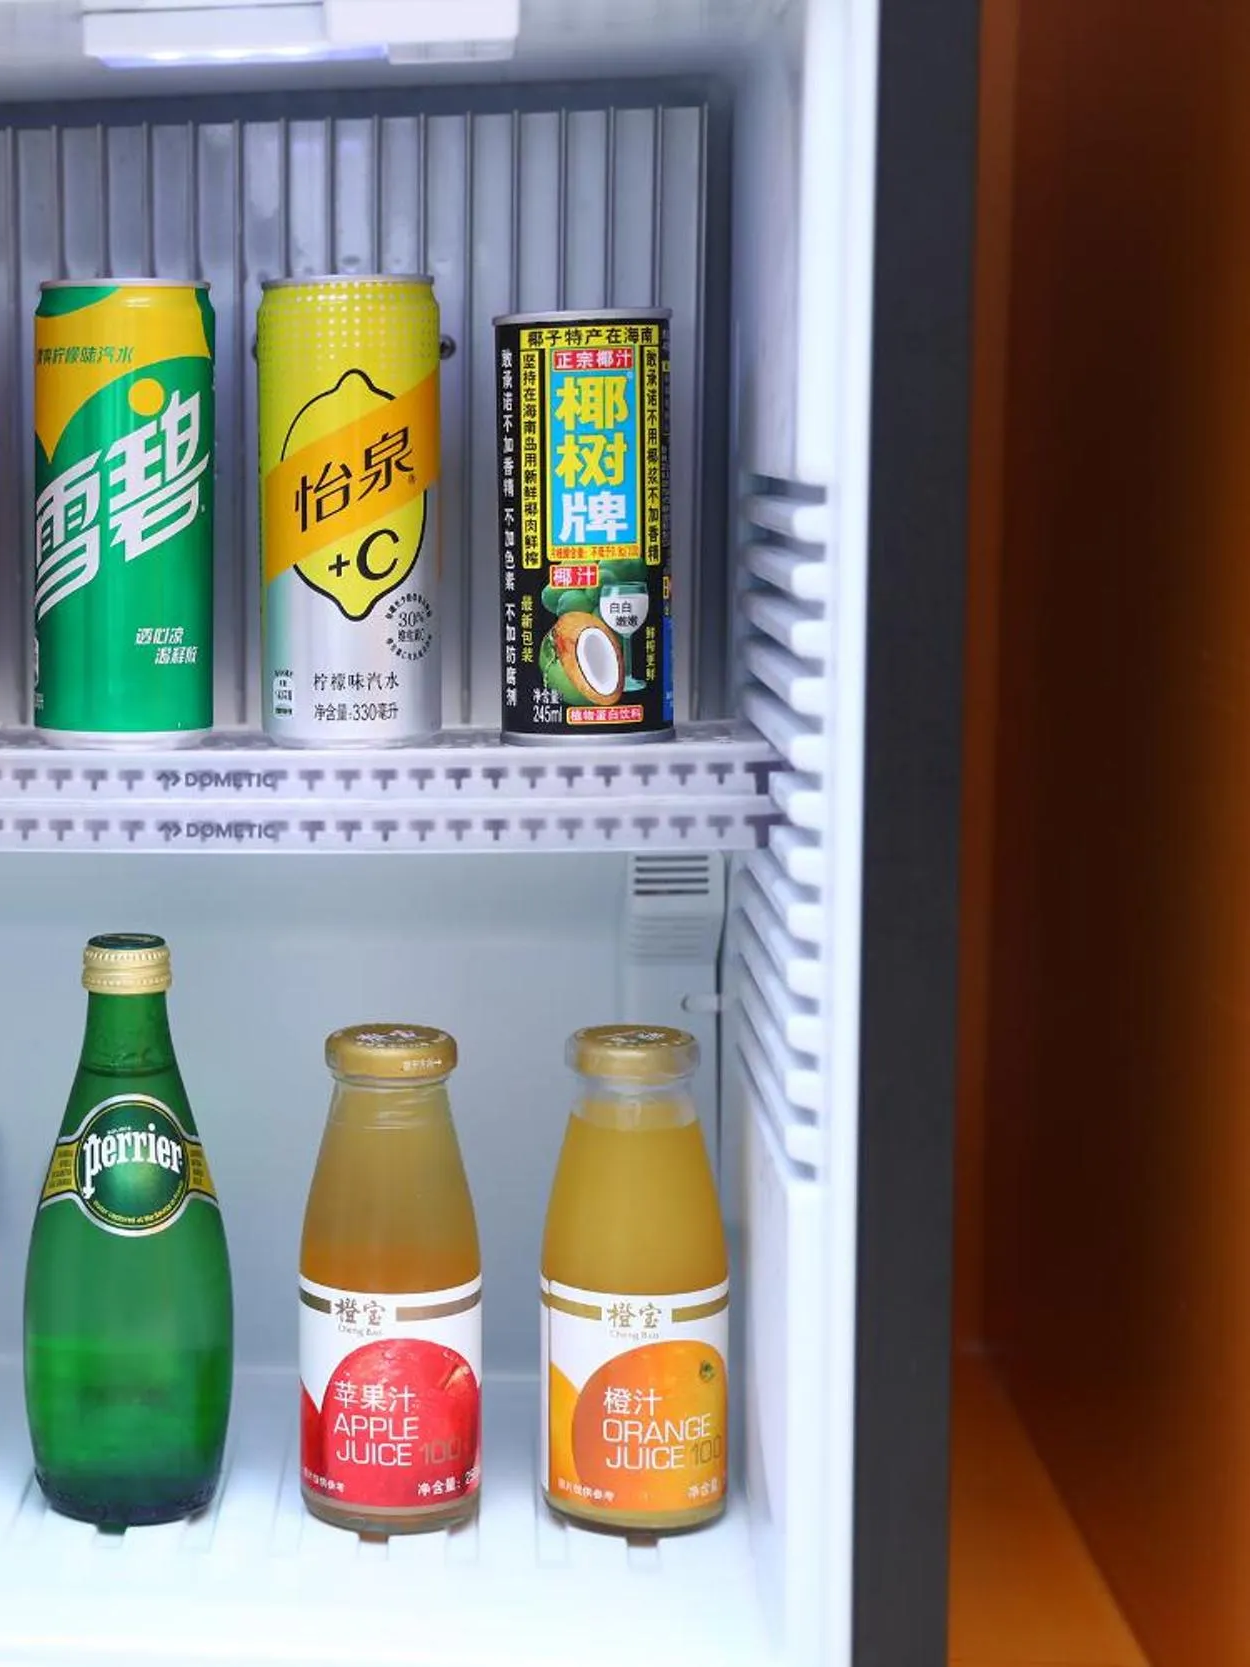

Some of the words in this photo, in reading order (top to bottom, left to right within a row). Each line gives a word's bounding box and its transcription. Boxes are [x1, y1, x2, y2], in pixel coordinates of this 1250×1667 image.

[528, 327, 653, 347] 椰子特产在海南
[556, 351, 630, 369] 正宗椰汁
[555, 376, 629, 542] 椰树牌
[294, 426, 414, 533] 怡泉
[35, 390, 209, 622] 雪碧
[553, 567, 596, 586] 椰汁
[609, 602, 631, 613] 白白
[313, 671, 399, 691] 柠檬味汽水
[533, 705, 562, 723] 245ml
[184, 771, 277, 788] DOMETIC
[186, 822, 279, 839] DOMETIC
[82, 1123, 183, 1199] perrier
[334, 1379, 416, 1413] 苹果汁
[604, 1387, 662, 1416] 橙汁
[333, 1412, 420, 1441] APPLE
[602, 1413, 711, 1444] ORANGE
[336, 1440, 413, 1467] JUICE
[606, 1445, 686, 1470] JUICE
